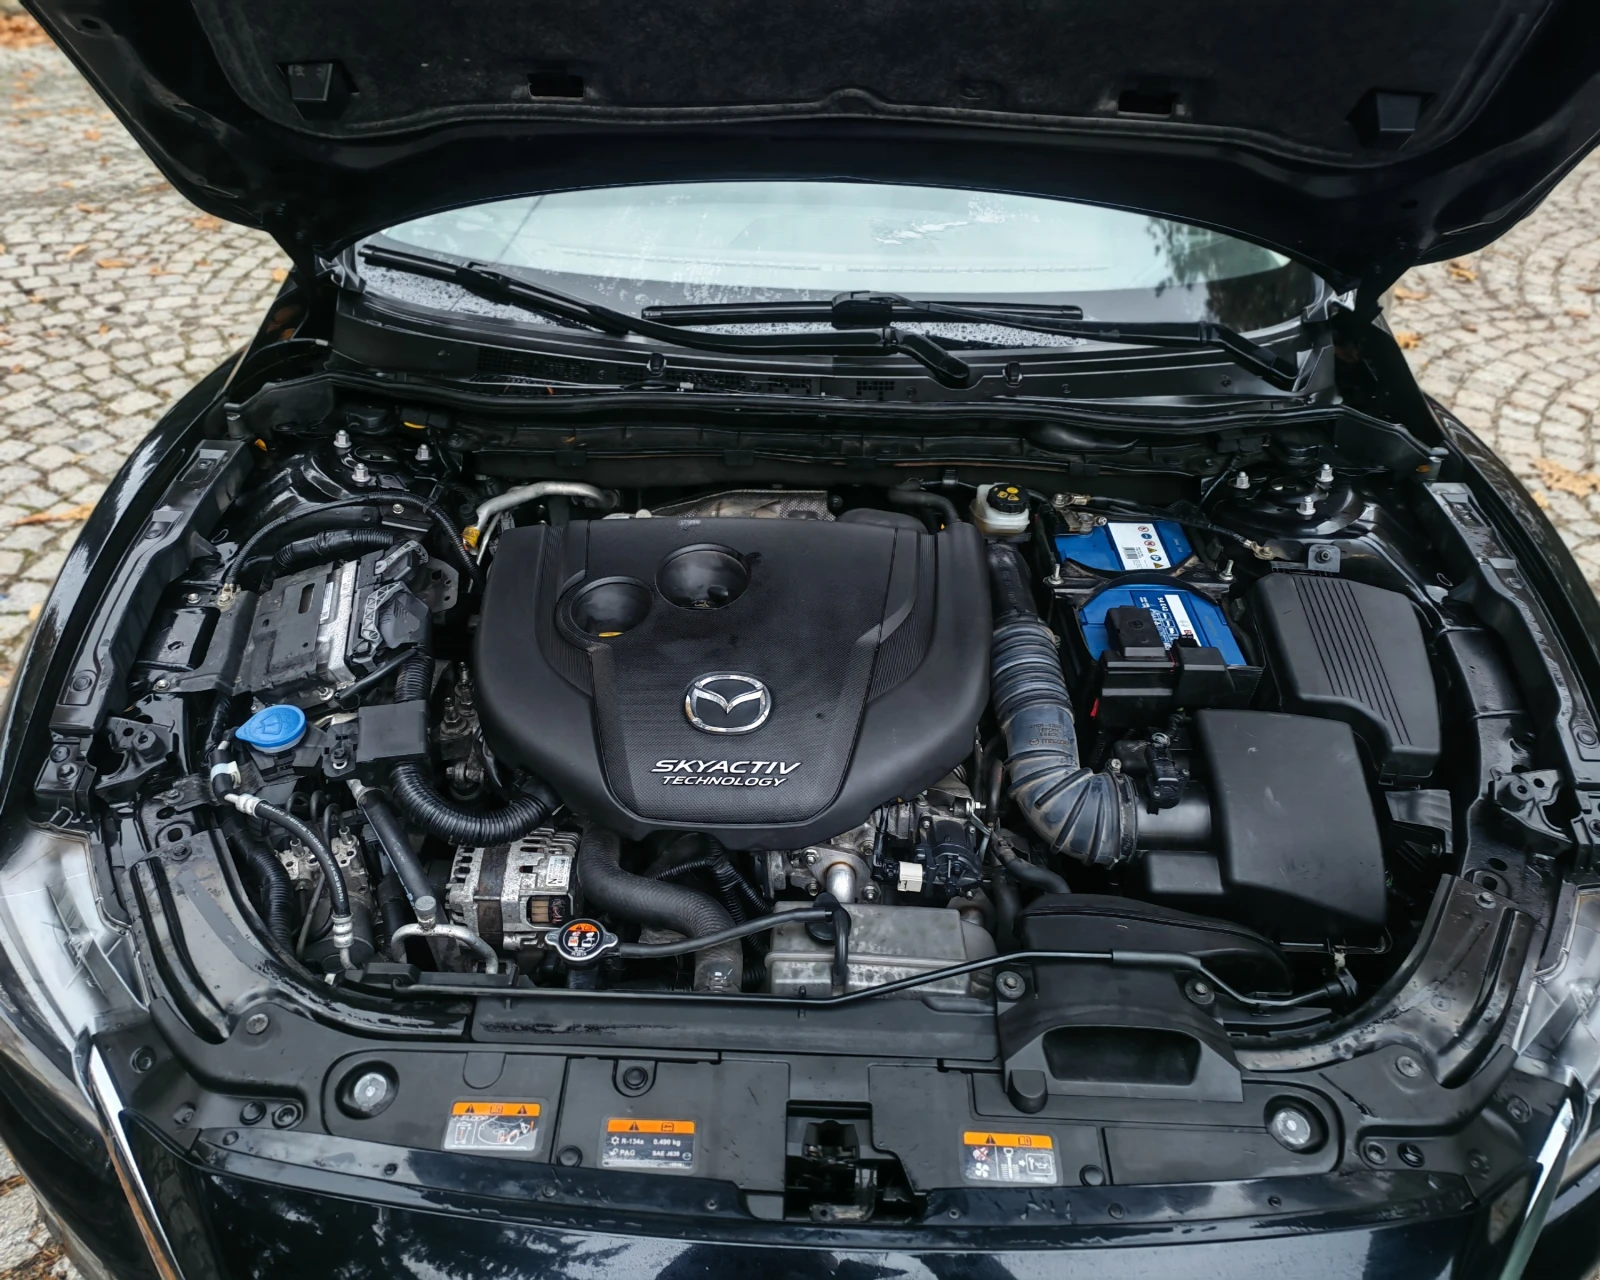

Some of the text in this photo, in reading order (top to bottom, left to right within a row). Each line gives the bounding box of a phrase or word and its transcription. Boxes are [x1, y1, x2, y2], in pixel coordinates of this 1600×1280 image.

[650, 759, 801, 775] SKYACTIV
[662, 775, 786, 787] TECHNOLOGY
[672, 1138, 681, 1147] kg
